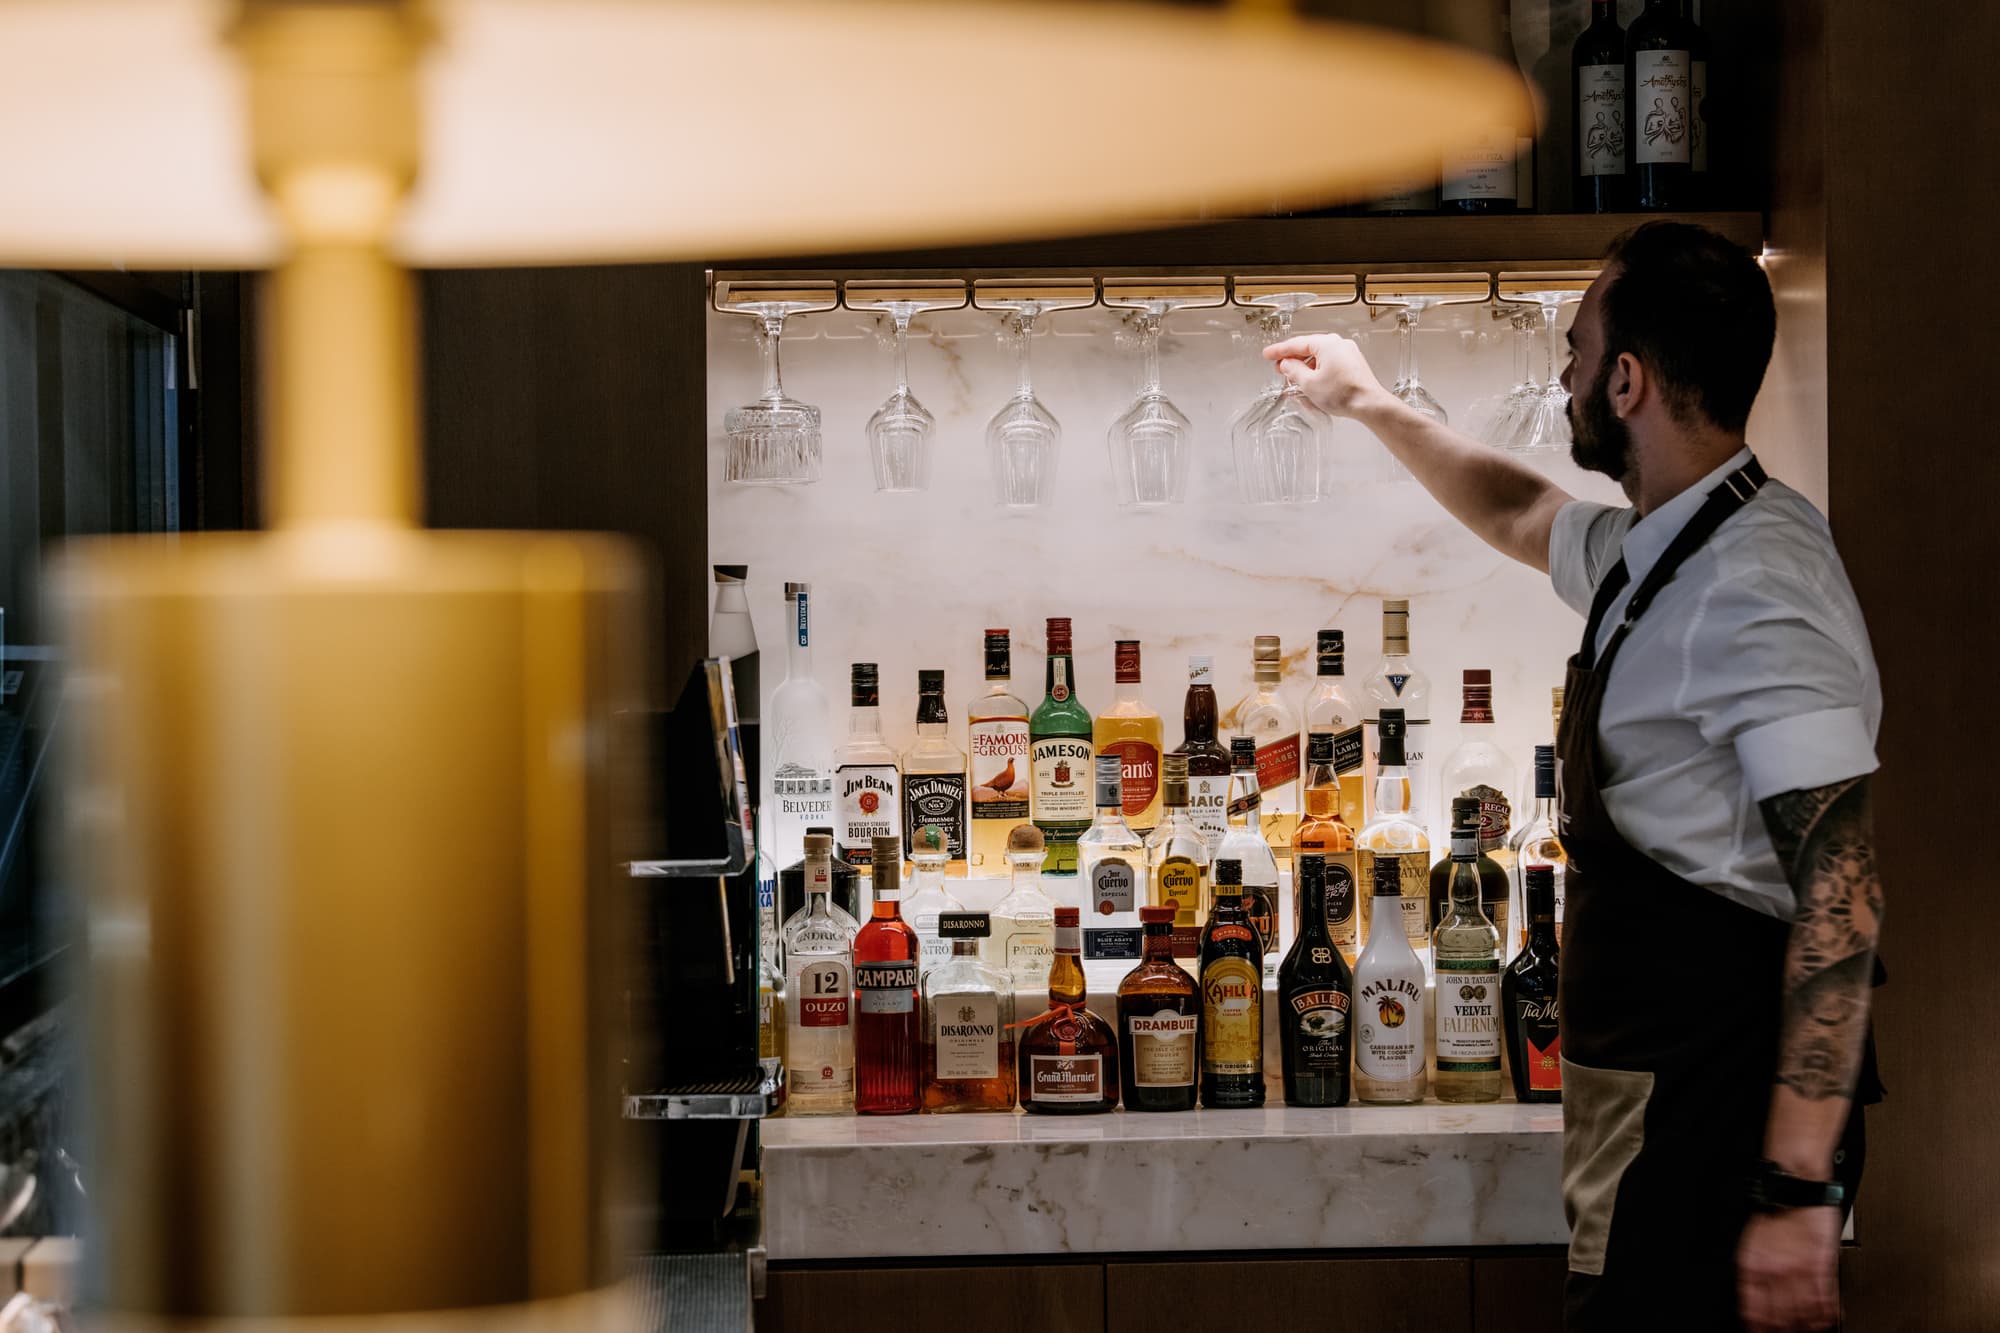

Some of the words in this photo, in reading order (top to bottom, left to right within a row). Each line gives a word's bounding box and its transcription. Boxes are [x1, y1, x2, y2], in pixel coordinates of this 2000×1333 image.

[979, 733, 1028, 745] FAMOUS
[979, 745, 1028, 756] GROUSE
[1033, 744, 1091, 762] JAMESON
[1335, 741, 1362, 756] LABEL
[1269, 750, 1297, 767] LABEL
[843, 780, 863, 798] JIM
[864, 775, 893, 797] BEAM
[908, 785, 931, 802] JACK
[930, 780, 964, 801] DANIEL'S
[1188, 796, 1224, 808] HAIG
[1484, 802, 1510, 816] REGAL
[918, 814, 955, 823] Tennessee
[848, 827, 890, 839] BOURBON
[1098, 875, 1129, 891] Cuervo
[1163, 873, 1194, 889] Cuervo
[943, 920, 985, 930] DISARONNO
[813, 971, 840, 994] 12
[856, 968, 918, 988] CAMPARI
[1446, 976, 1463, 985] JOHN
[1361, 979, 1422, 1003] MALIBU
[805, 1002, 846, 1013] OUZO
[1296, 993, 1347, 1011] BAILEYS
[1454, 1005, 1492, 1016] VELVET
[1516, 1000, 1541, 1020] Tia
[941, 1025, 994, 1037] DISARONNO
[1134, 1019, 1195, 1031] DRAMBUIE
[1444, 1016, 1499, 1033] FALERNUM
[1037, 1071, 1060, 1083] Grand
[1060, 1071, 1096, 1083] Marnier
